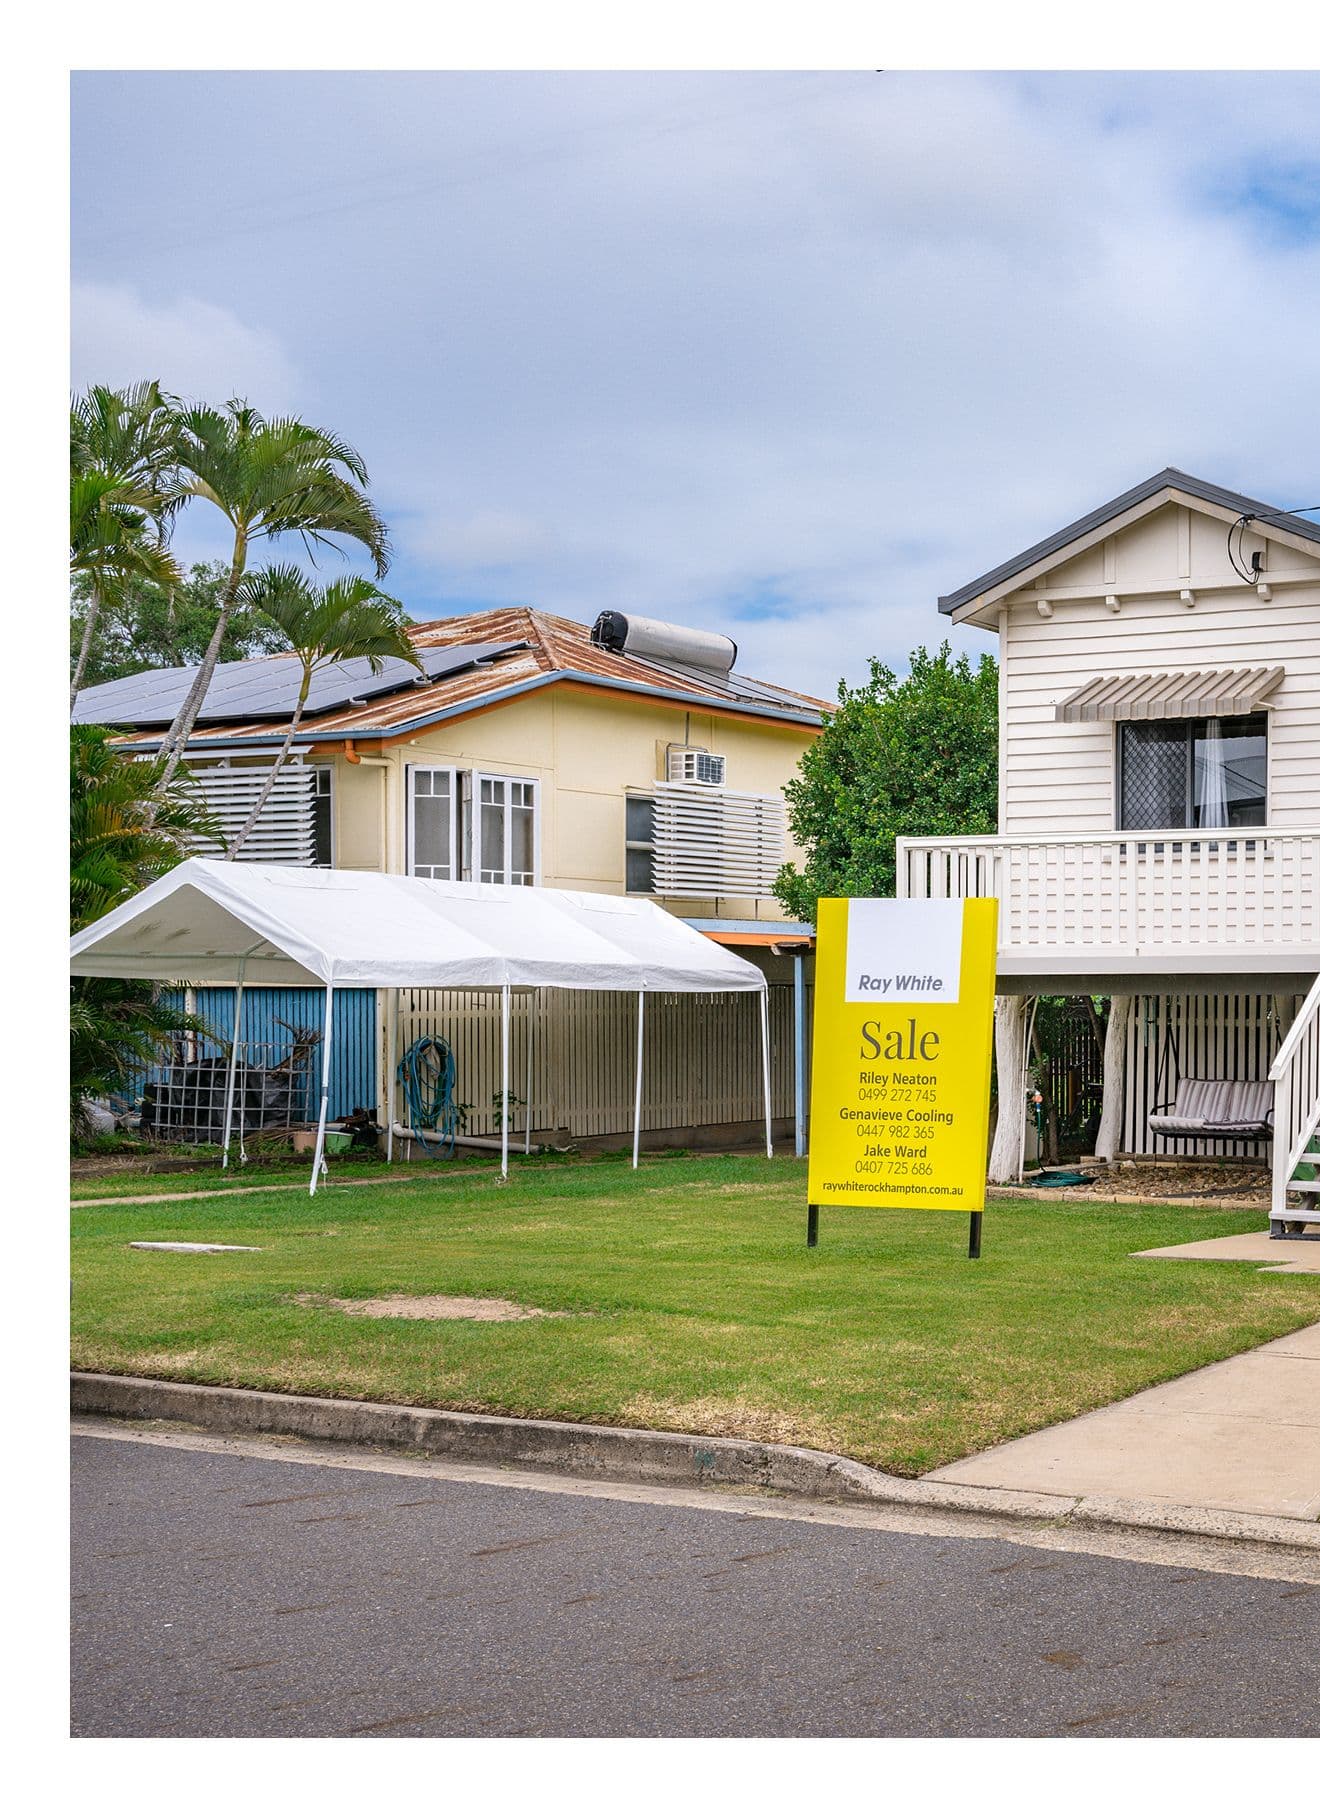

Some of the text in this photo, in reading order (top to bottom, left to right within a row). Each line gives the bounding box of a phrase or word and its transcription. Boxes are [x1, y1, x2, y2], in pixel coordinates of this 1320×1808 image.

[859, 975, 943, 993] Ray White
[860, 1019, 940, 1061] Sale
[859, 1072, 937, 1087] Riley Neaton
[858, 1088, 937, 1102] 0499 272 745
[839, 1108, 954, 1125] Genavieve Cooling
[856, 1124, 935, 1139] 0447 982 365
[863, 1144, 927, 1158] Jake Ward
[855, 1161, 933, 1176] 0407 725 686
[823, 1181, 964, 1196] raywhiterockhampton.com.au
